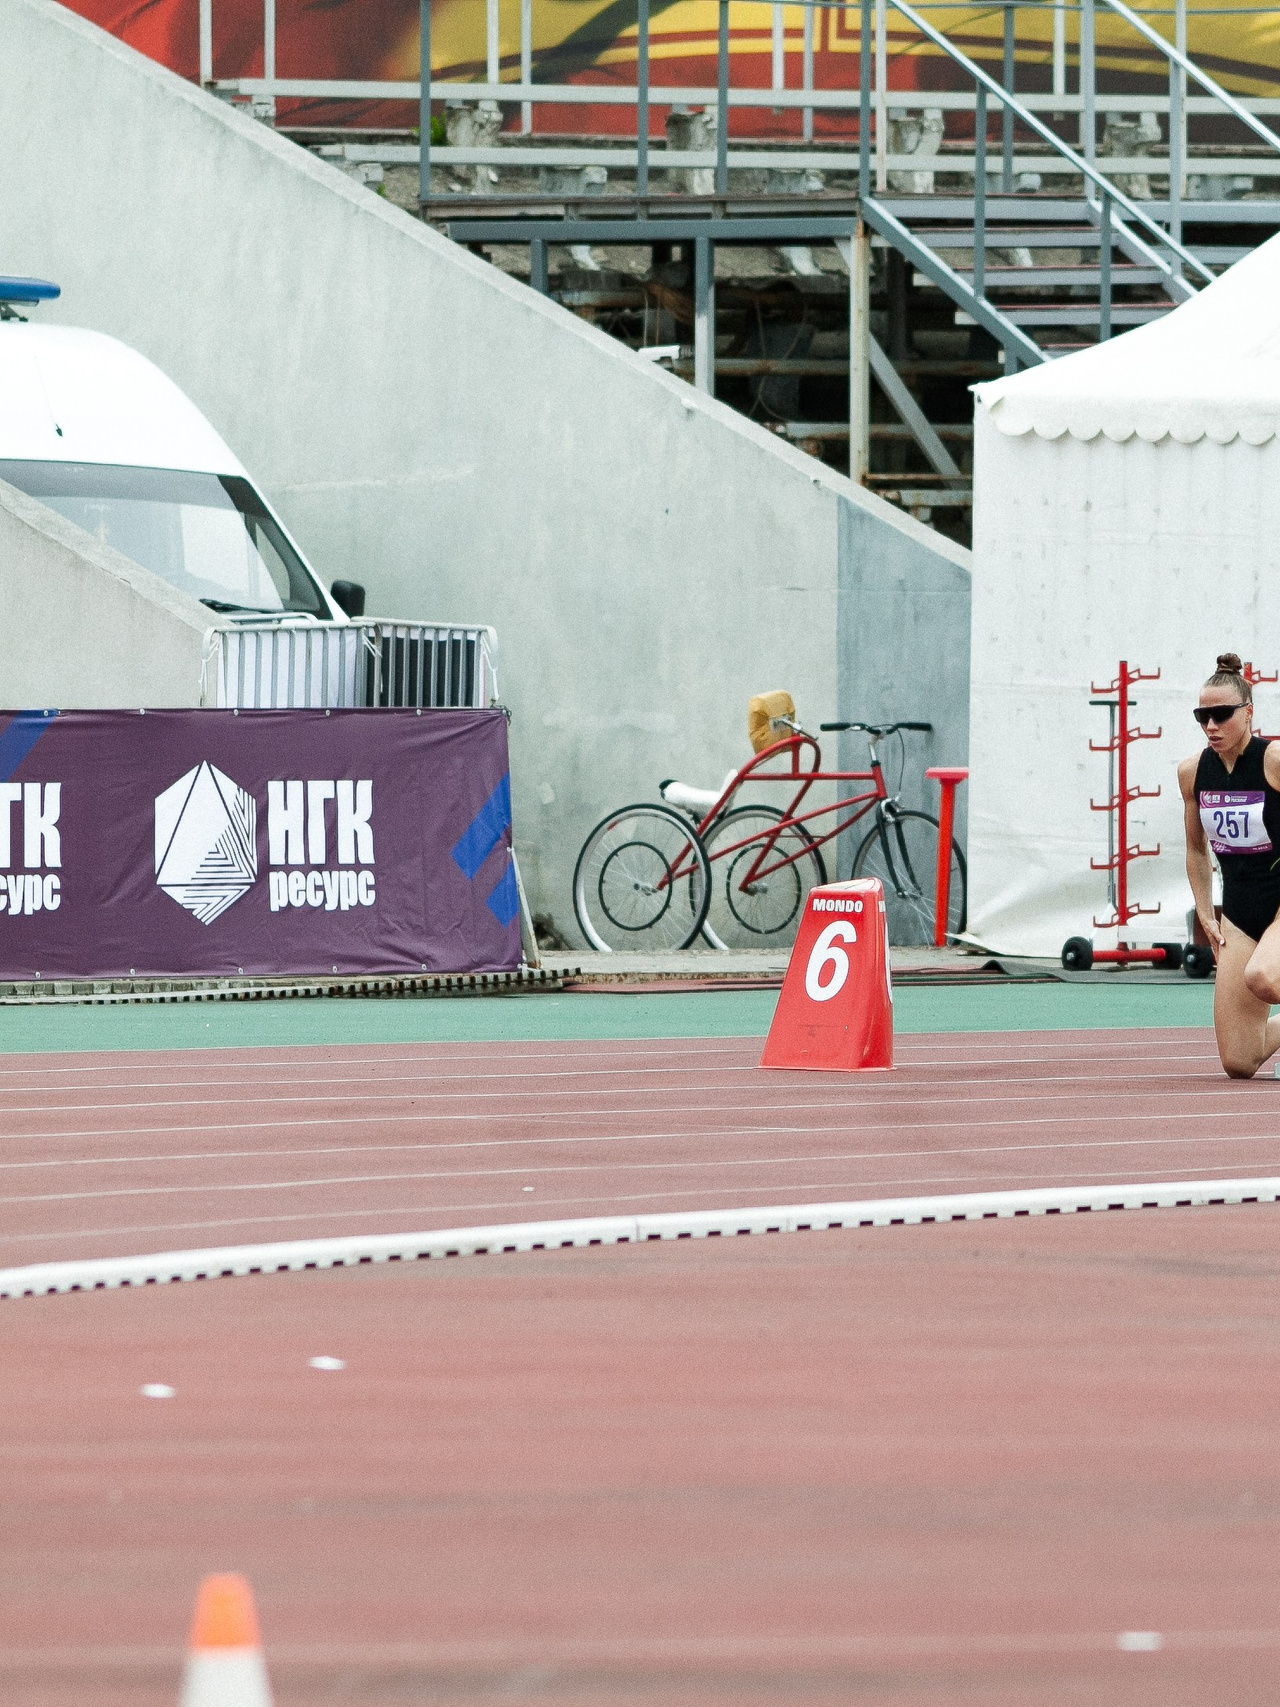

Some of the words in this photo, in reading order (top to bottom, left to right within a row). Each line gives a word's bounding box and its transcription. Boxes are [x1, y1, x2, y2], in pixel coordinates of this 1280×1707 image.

[267, 780, 375, 865] НГК
[1213, 811, 1249, 838] 257
[269, 870, 376, 912] ресурс
[812, 898, 864, 913] MONDO
[805, 920, 857, 1002] 6
